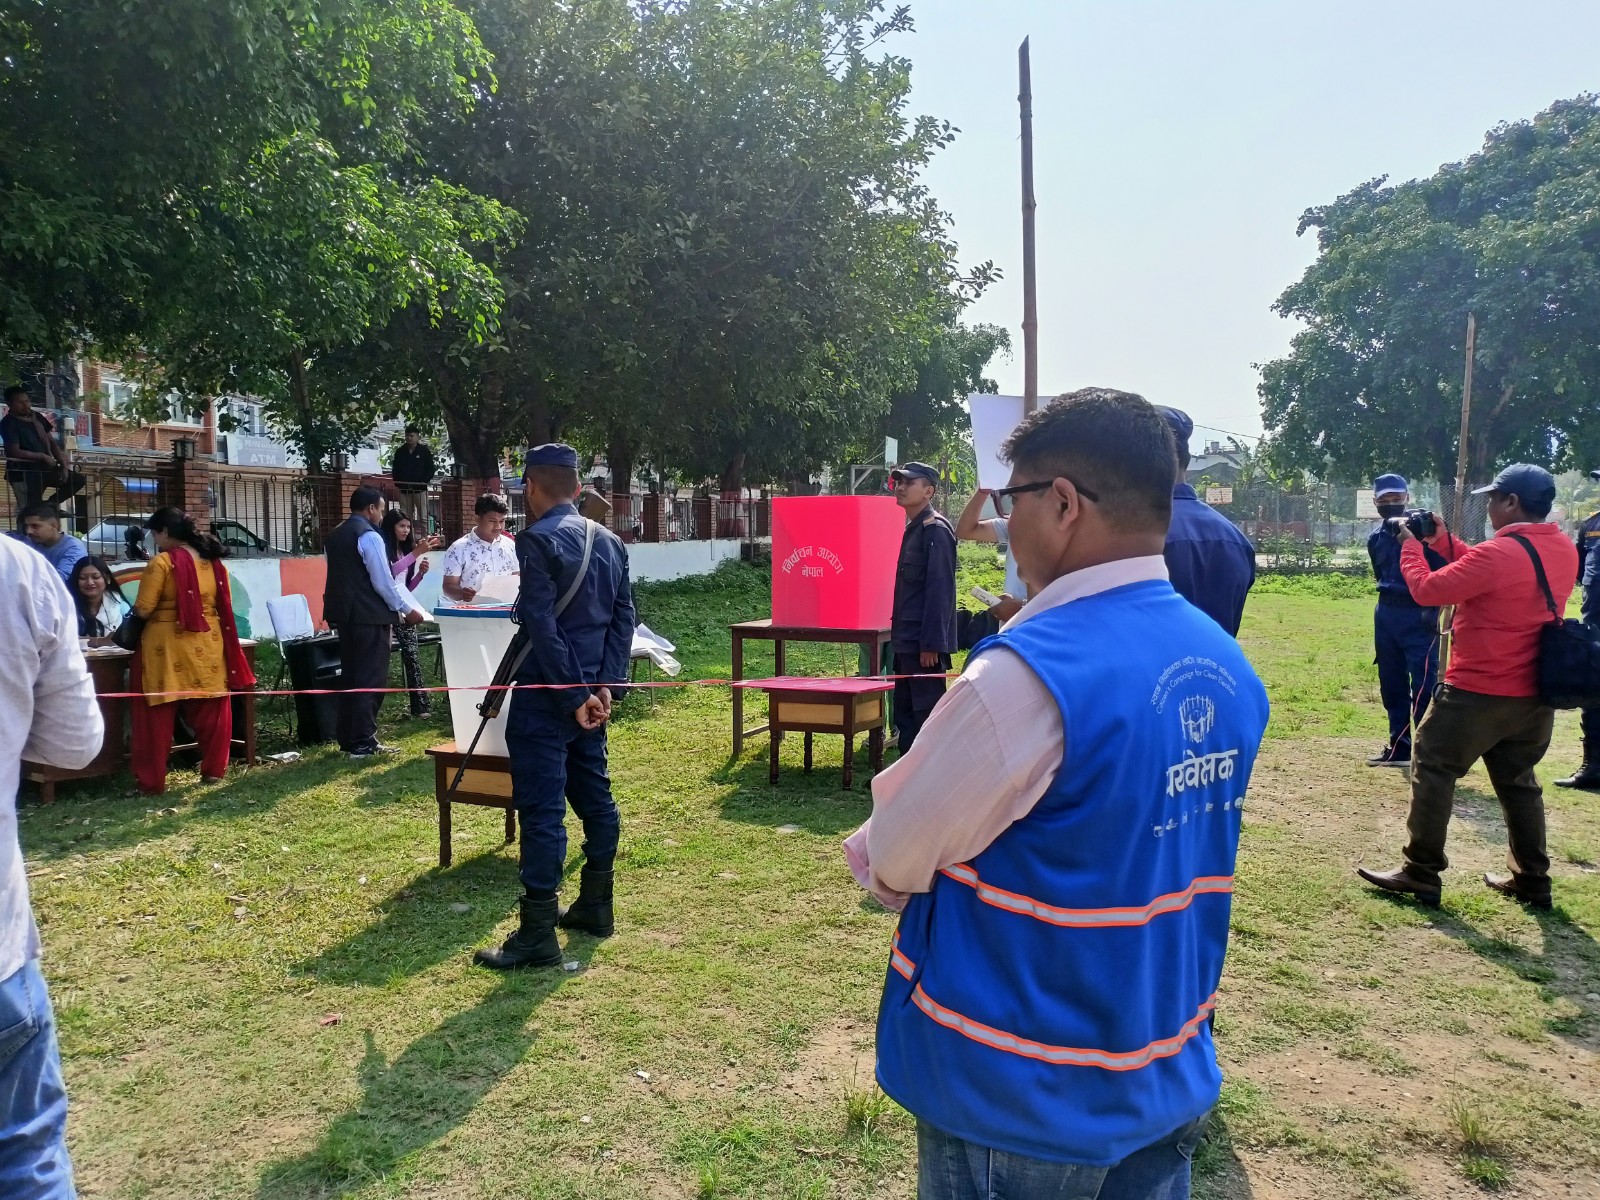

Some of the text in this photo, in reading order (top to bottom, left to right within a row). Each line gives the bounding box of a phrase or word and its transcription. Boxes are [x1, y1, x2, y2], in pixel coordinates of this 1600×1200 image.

[250, 453, 276, 465] ATM
[781, 545, 844, 575] निर्वाचन आयोग
[801, 564, 824, 578] नेपाल
[1170, 671, 1195, 688] Campaign
[1203, 669, 1218, 681] Clean
[1217, 676, 1236, 697] Election
